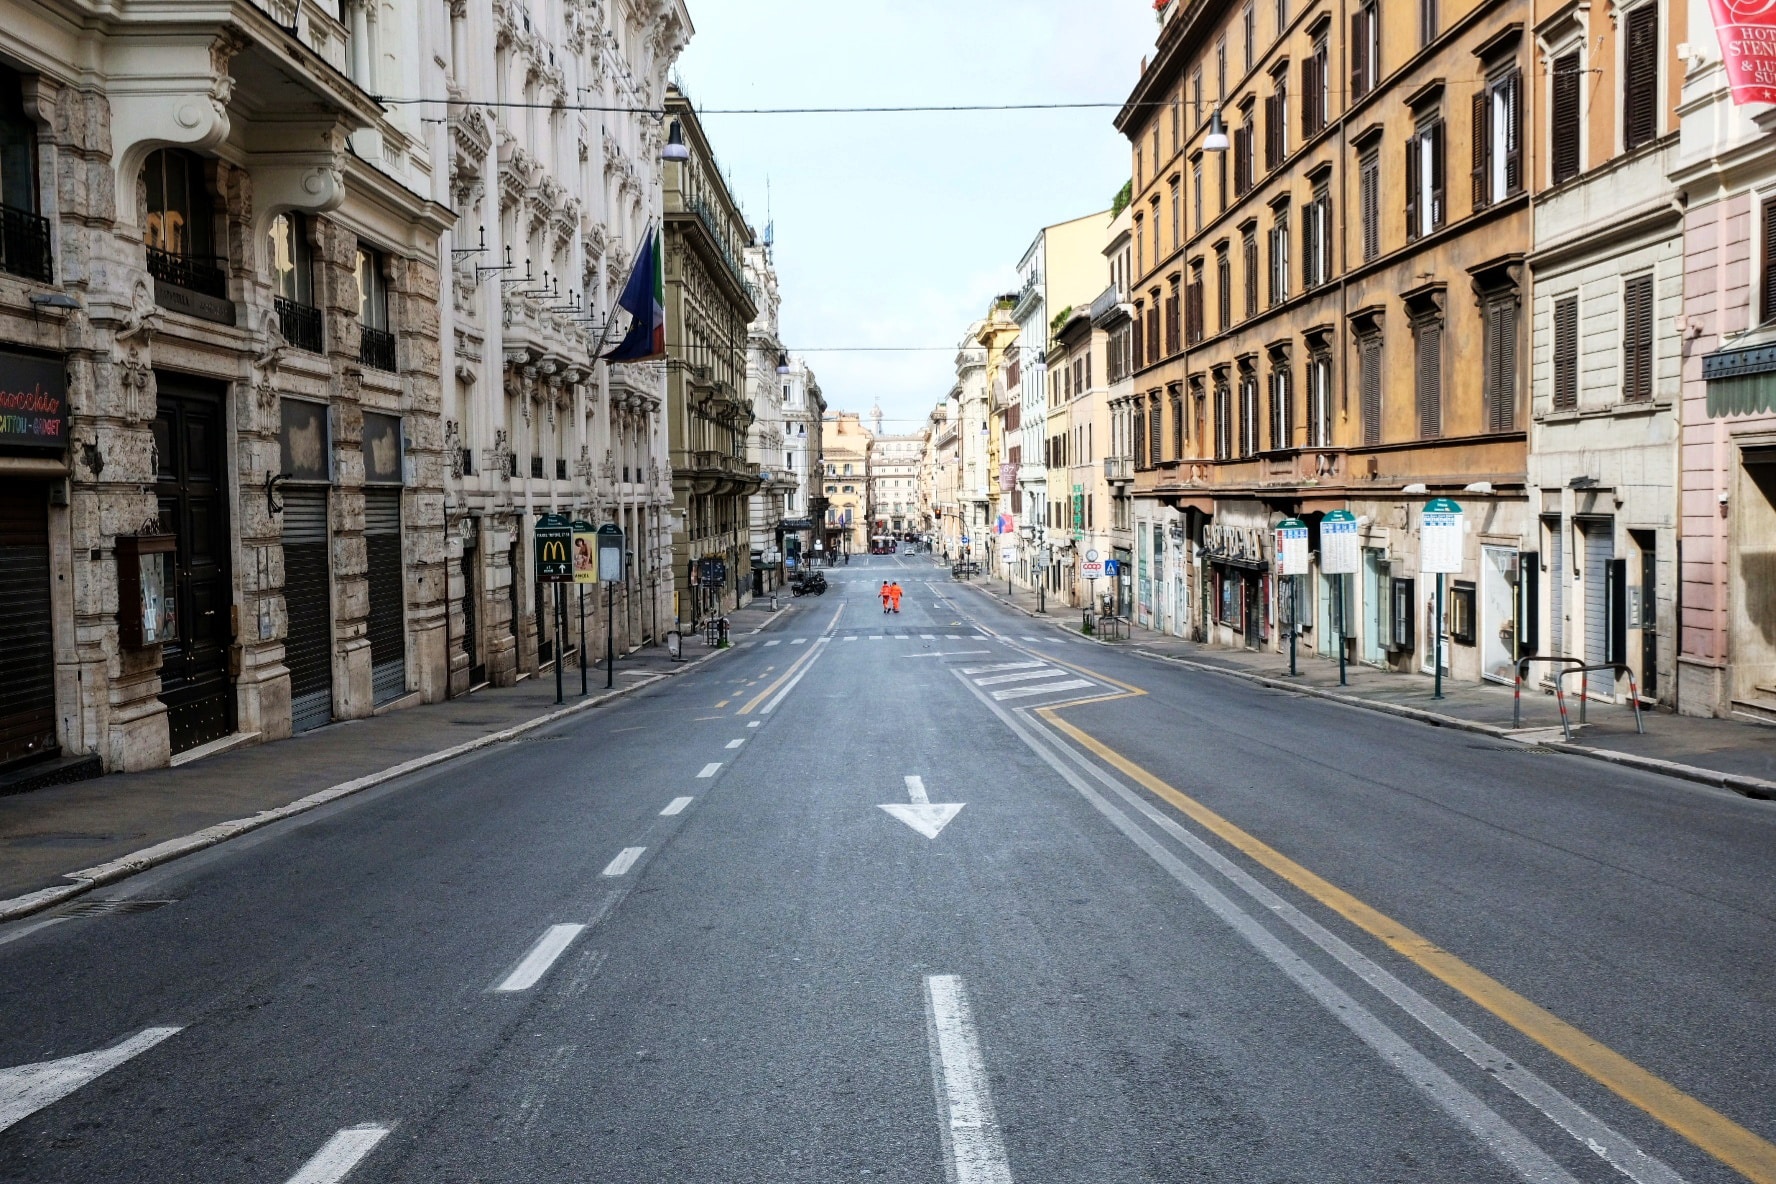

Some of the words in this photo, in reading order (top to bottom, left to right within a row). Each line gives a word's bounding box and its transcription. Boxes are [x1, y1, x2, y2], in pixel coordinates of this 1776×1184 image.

[1741, 60, 1753, 72] &
[1072, 484, 1083, 534] HOTEL
[1083, 563, 1102, 571] coop
